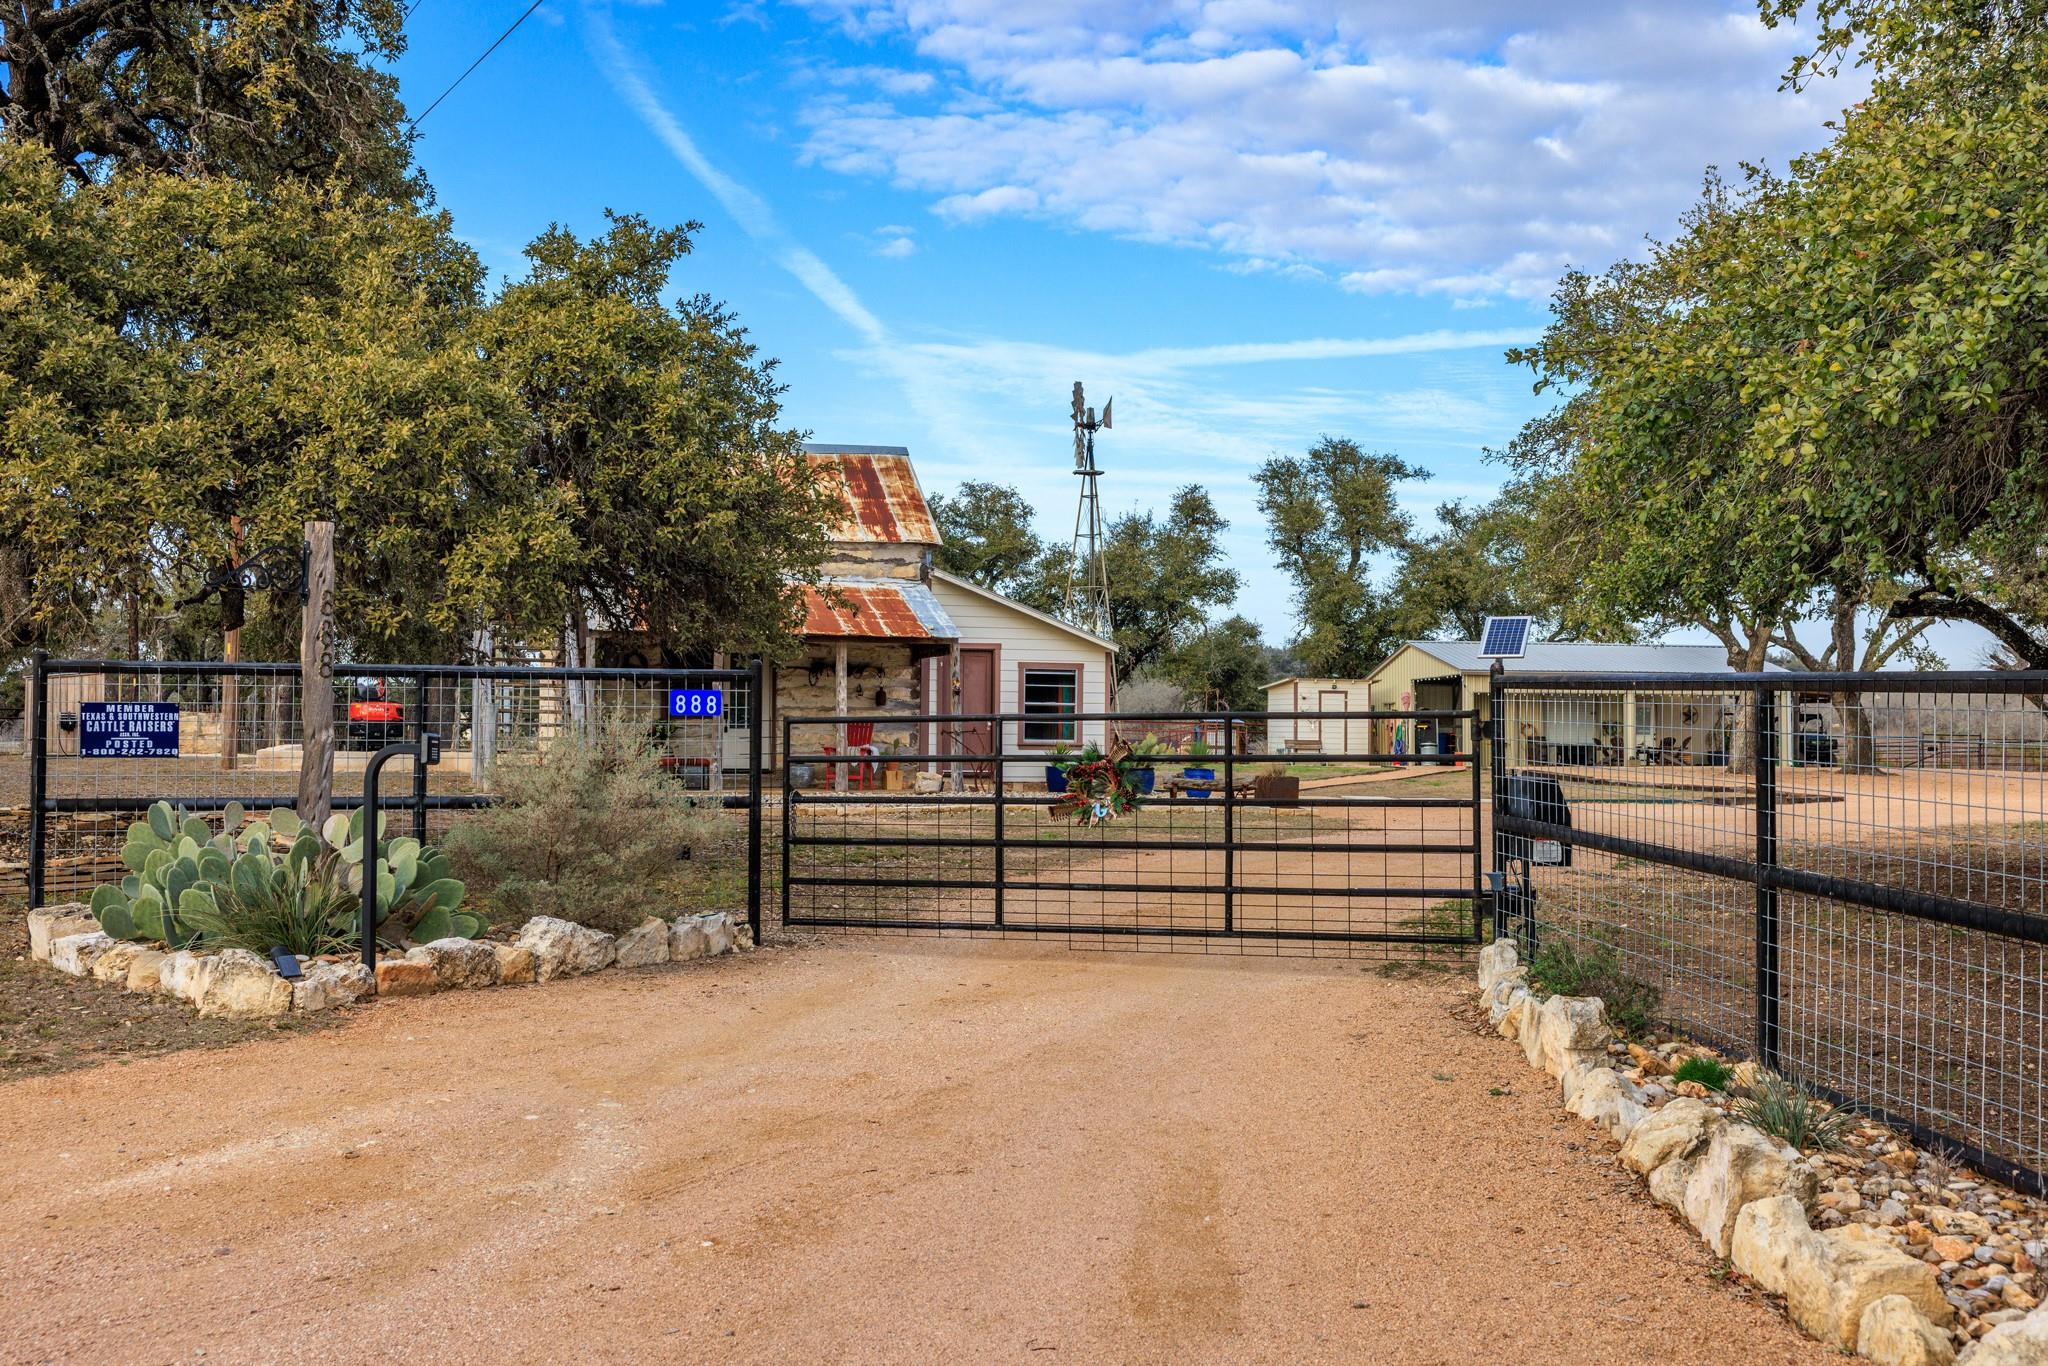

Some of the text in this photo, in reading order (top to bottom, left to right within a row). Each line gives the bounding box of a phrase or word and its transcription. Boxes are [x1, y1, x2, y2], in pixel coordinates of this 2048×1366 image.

[106, 704, 154, 712] MEMBER
[675, 694, 717, 714] 888
[81, 712, 179, 721] TEXAS & SOUTHWESTERN
[86, 720, 125, 732] CATTLE
[105, 740, 153, 748] POSTED
[81, 748, 179, 756] 1-800-242-7820
